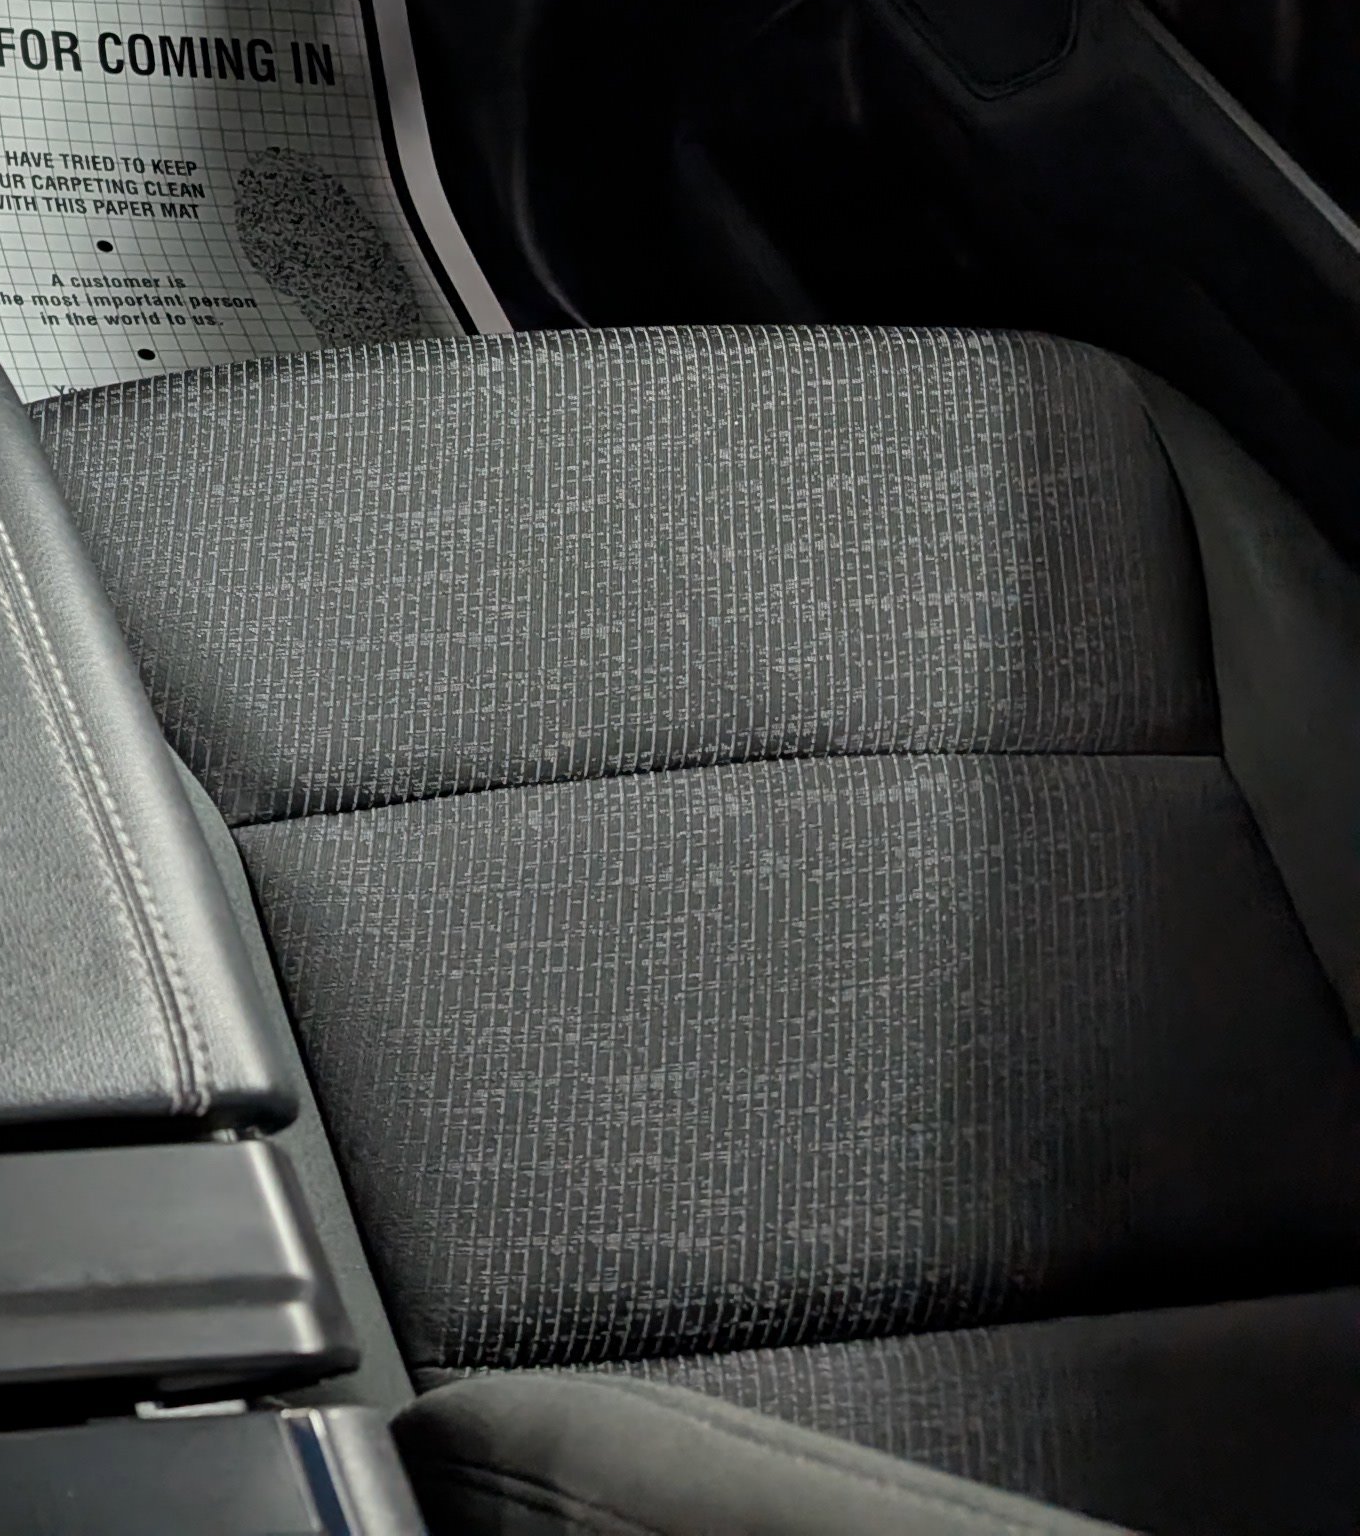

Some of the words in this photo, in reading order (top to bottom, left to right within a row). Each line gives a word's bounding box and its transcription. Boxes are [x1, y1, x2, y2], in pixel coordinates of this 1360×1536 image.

[97, 31, 276, 85] COMING
[293, 41, 336, 87] IN
[5, 150, 55, 169] HAVE
[58, 153, 115, 172] TRIED
[120, 157, 145, 174] TO
[151, 158, 197, 177] KEEP
[32, 174, 139, 196] CARPETING
[145, 180, 205, 199] CLEAN
[42, 197, 87, 214] THIS
[94, 200, 156, 218] PAPER
[161, 203, 200, 220] MAT
[51, 273, 64, 288] A
[70, 274, 160, 289] customer
[167, 274, 187, 289] is
[31, 292, 80, 306] most
[86, 293, 183, 309] important
[189, 295, 257, 310] person
[40, 311, 60, 326] in
[66, 312, 98, 326] the
[104, 312, 160, 326] world
[167, 312, 186, 326] to
[193, 315, 224, 326] us.
